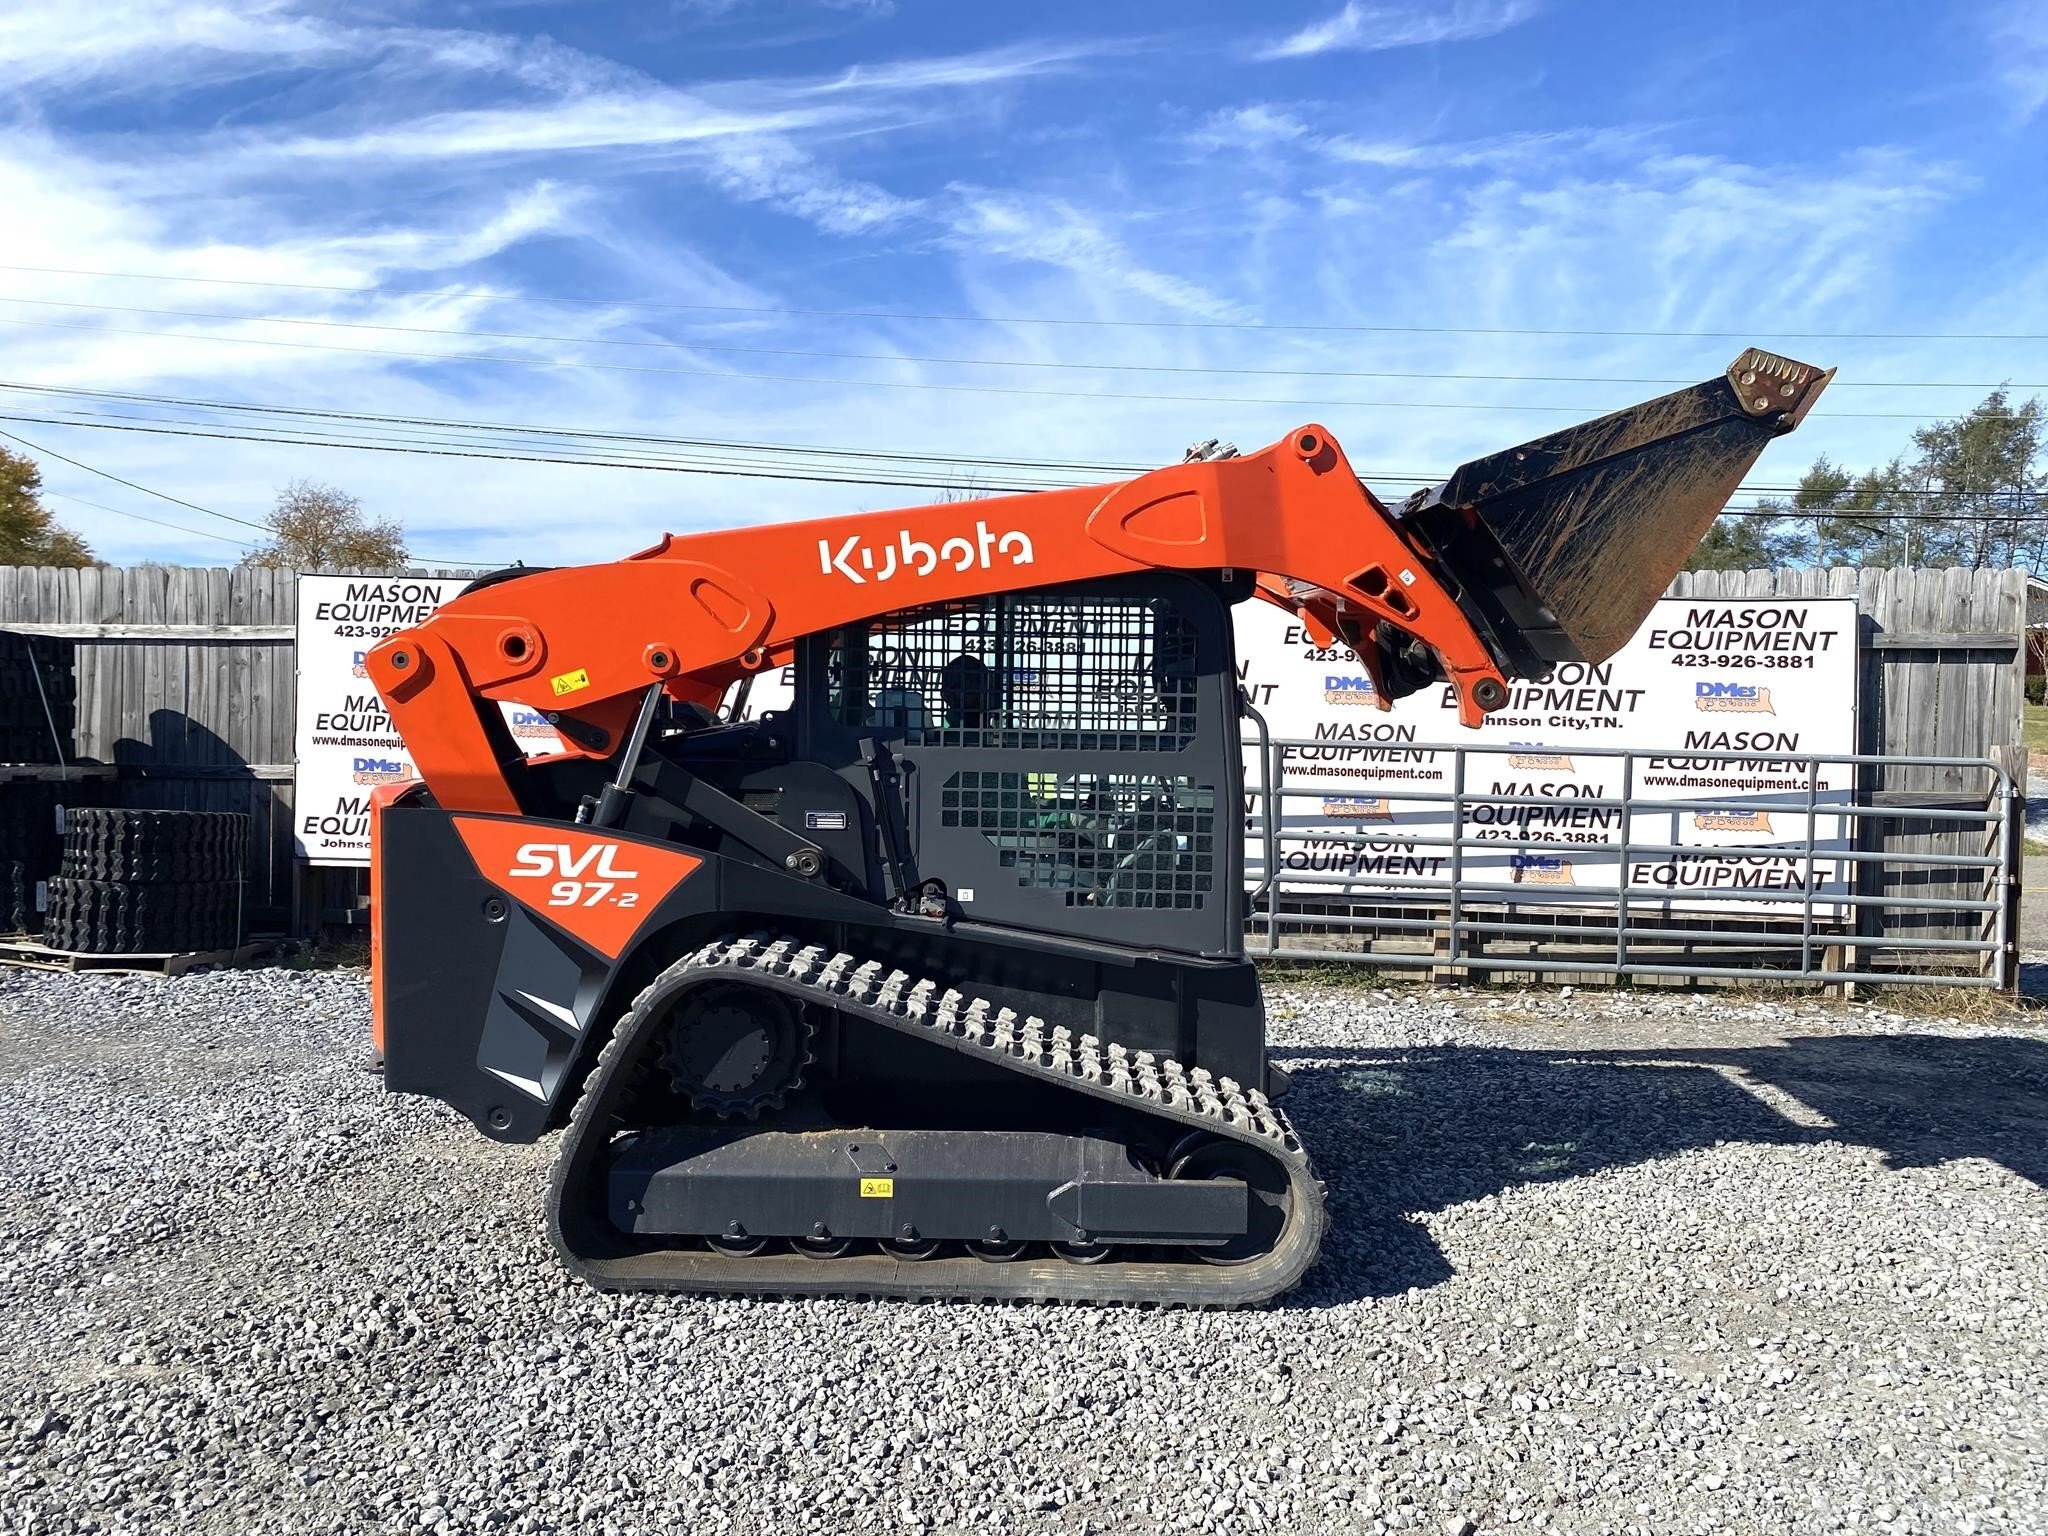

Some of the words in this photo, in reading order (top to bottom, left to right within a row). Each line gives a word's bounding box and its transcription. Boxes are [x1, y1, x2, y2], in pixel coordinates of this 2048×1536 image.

[818, 520, 1034, 584] Kubota
[346, 583, 442, 604] MASON
[315, 602, 438, 624] EQUIPME
[1686, 609, 1807, 629] MASON
[1649, 629, 1837, 651] EQUIPMENT
[1672, 653, 1815, 669] 423-926-3881
[1314, 723, 1417, 743] MASON
[1480, 715, 1542, 727] hnson
[1548, 715, 1623, 730] City,TN.
[312, 735, 407, 751] www.dmasonequip
[1684, 731, 1799, 752] MASON
[1491, 782, 1603, 799] MASON
[1643, 774, 1829, 791] www.dmasonequipment.cm
[509, 843, 639, 879] SVL
[1632, 864, 1832, 891] EQUIPMENT
[548, 881, 639, 907] 97-2
